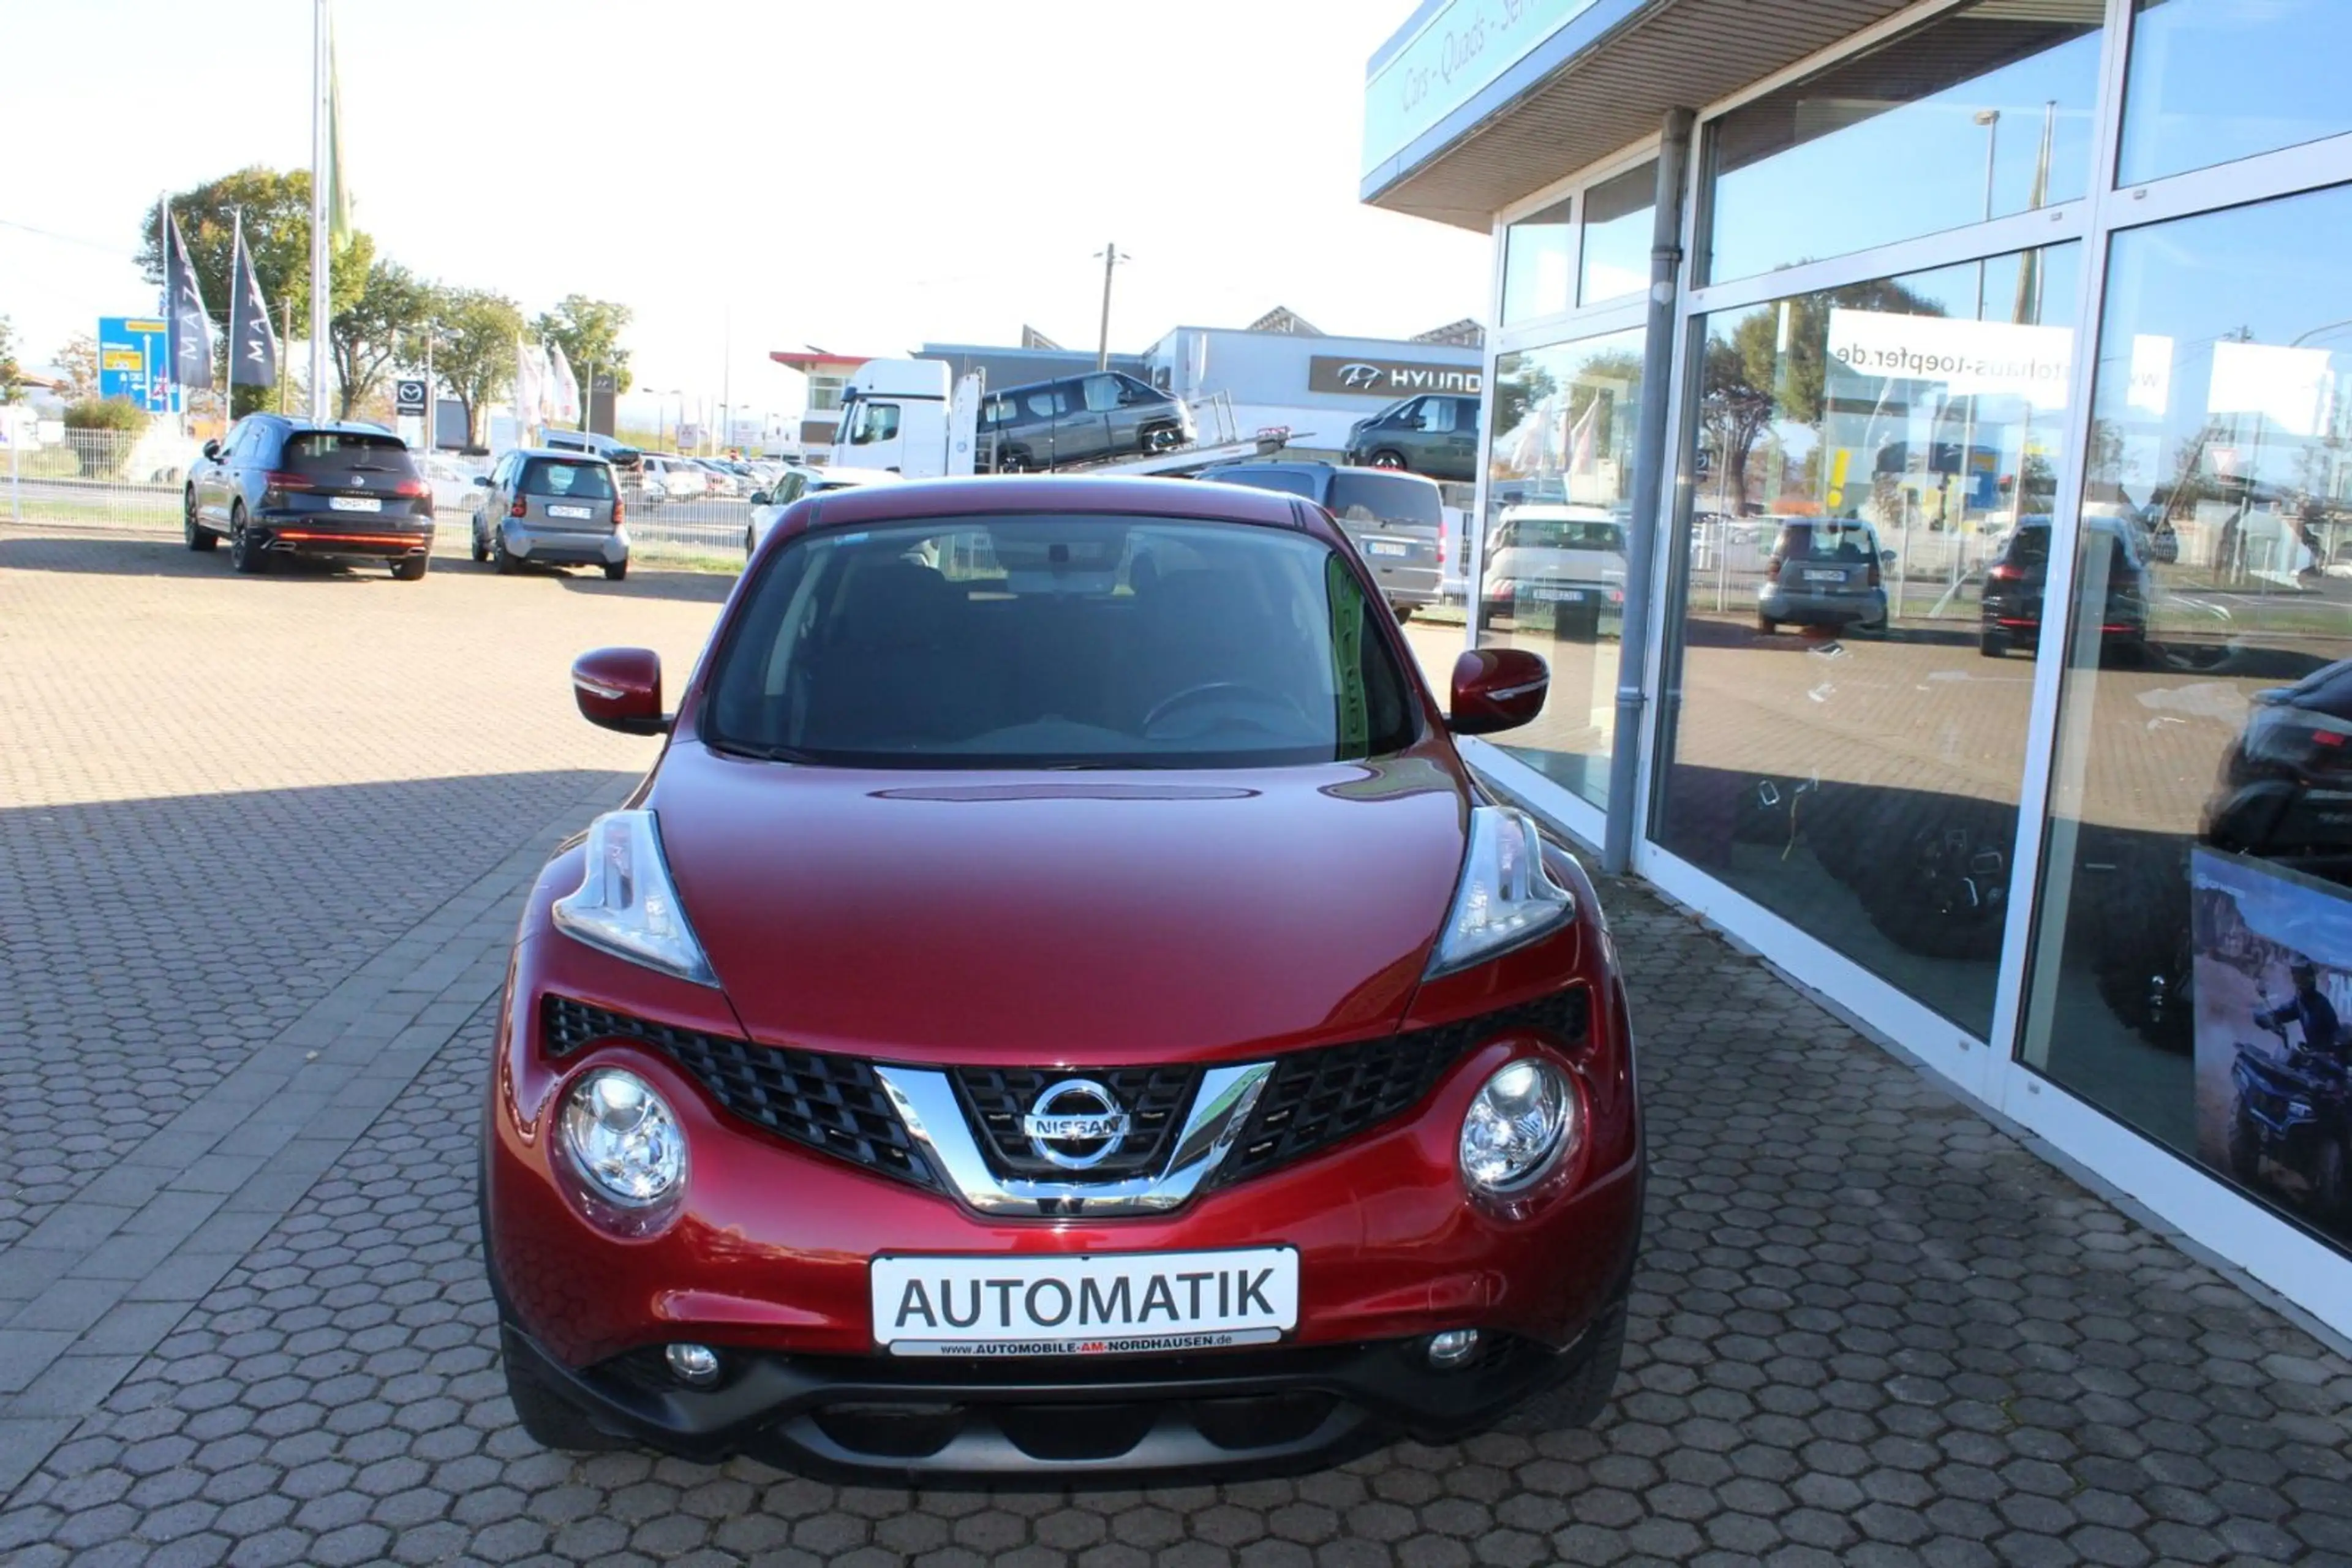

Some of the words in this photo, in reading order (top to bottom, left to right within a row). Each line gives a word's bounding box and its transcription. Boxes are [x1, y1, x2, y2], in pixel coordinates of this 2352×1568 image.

[179, 270, 201, 361] MAZ
[247, 292, 266, 363] MAZ
[1390, 368, 1482, 393] HYUND
[1036, 1118, 1120, 1134] NISSAN
[894, 1268, 1275, 1328] AUTOMATIK
